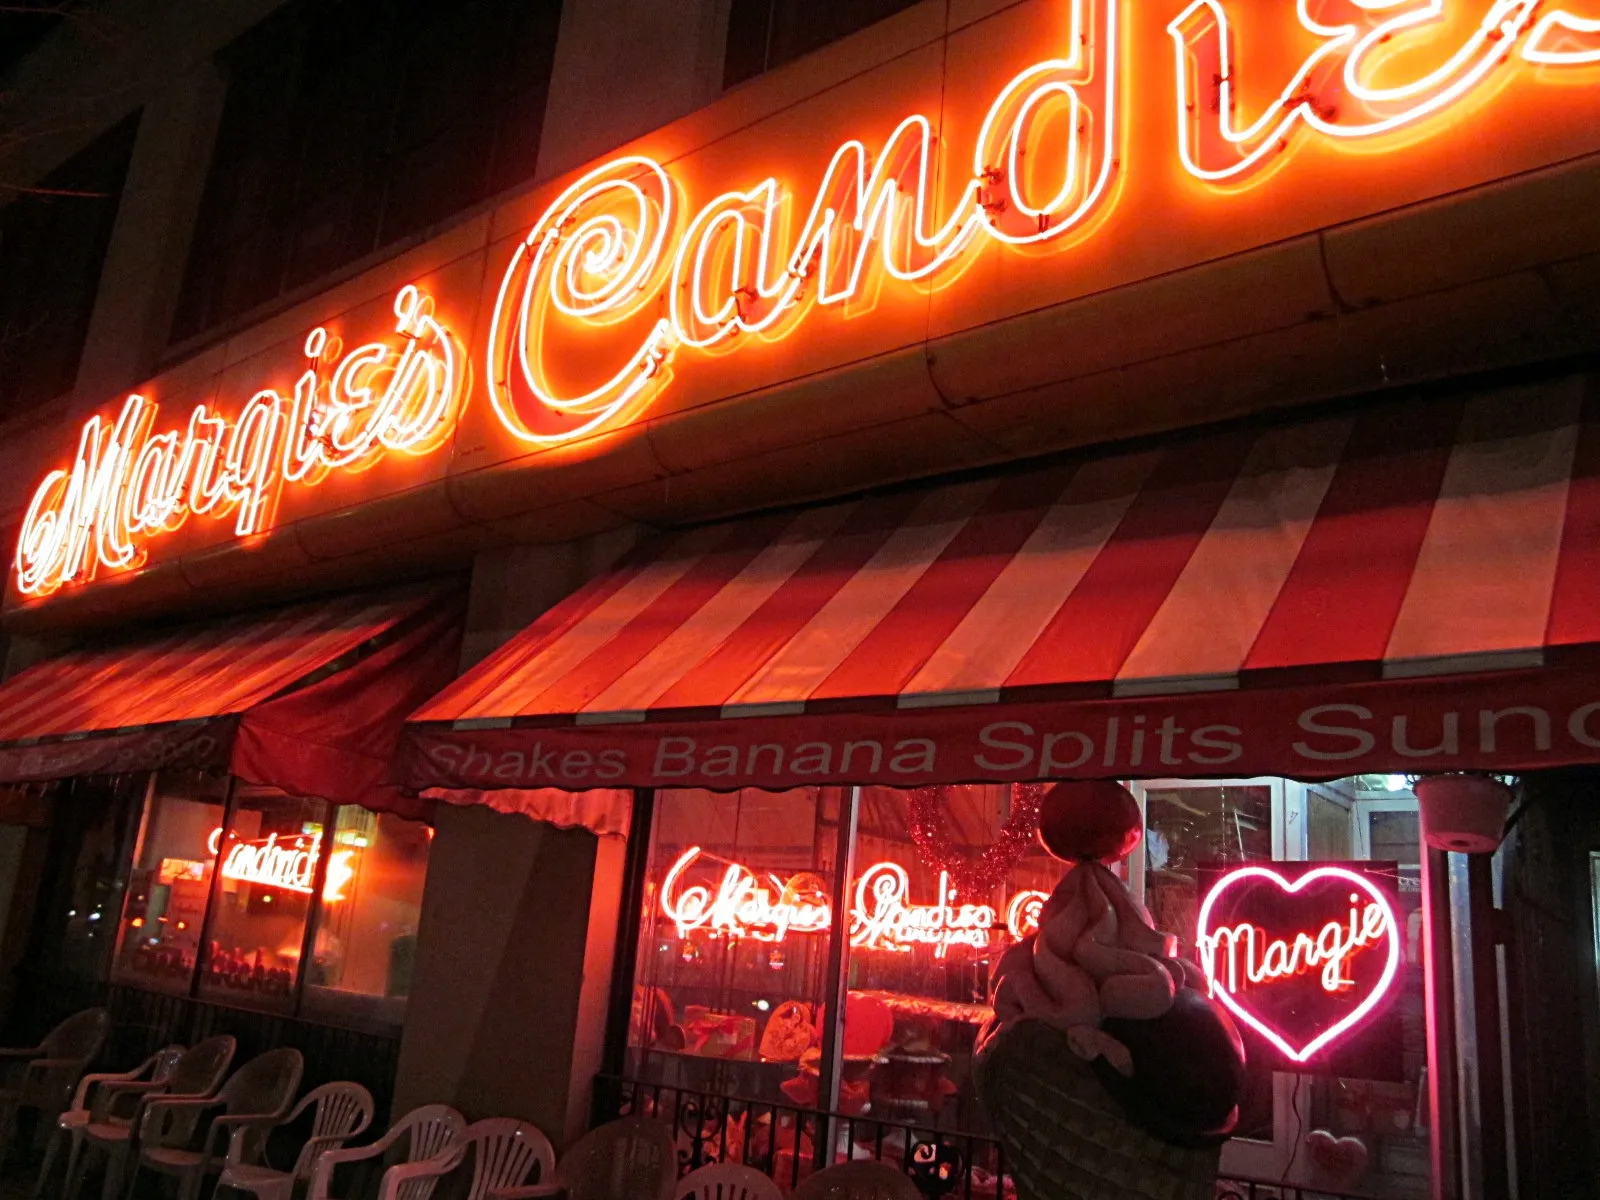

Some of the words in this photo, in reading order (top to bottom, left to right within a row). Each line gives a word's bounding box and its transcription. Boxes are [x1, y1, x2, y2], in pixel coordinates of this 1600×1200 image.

[431, 741, 627, 779] Shakes
[653, 736, 937, 778] Banana
[973, 718, 1244, 776] Splits
[1196, 893, 1388, 1000] Margie
